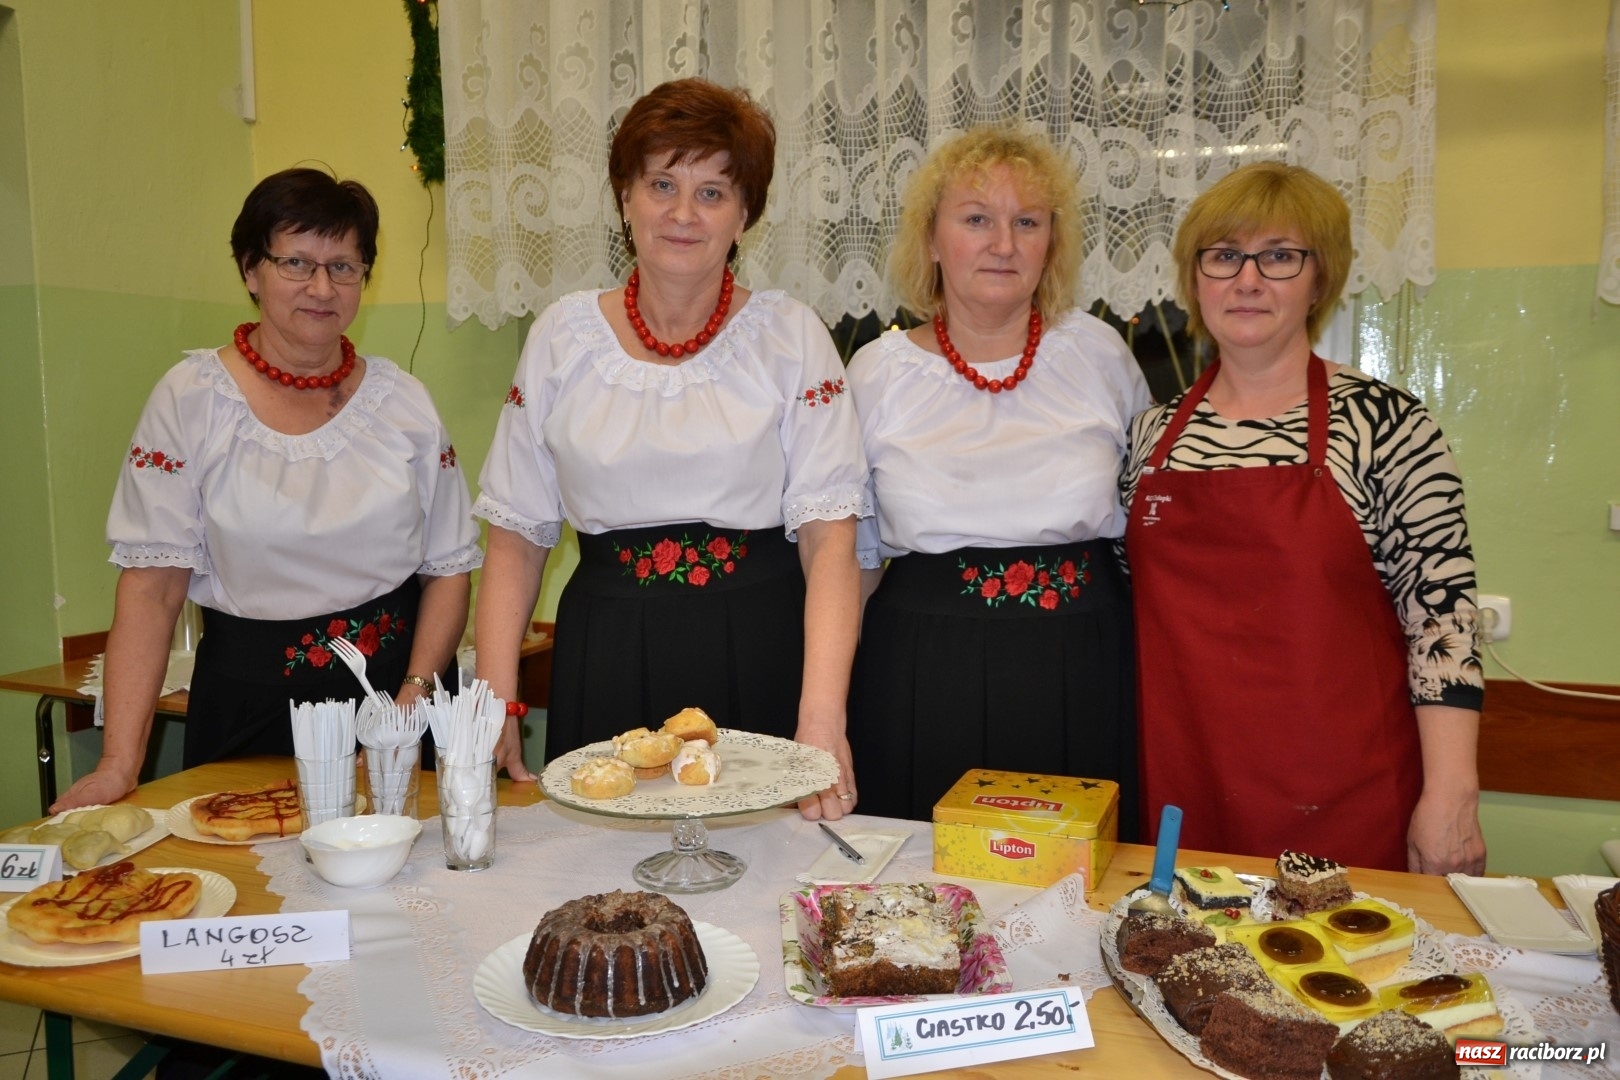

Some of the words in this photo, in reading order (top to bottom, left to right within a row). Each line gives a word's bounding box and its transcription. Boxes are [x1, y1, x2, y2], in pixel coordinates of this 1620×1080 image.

[981, 797, 1056, 811] Lipton
[993, 841, 1032, 855] Lipton
[162, 925, 313, 948] LANGOSZ
[221, 949, 234, 967] 4
[916, 1012, 1005, 1039] CIASTKO
